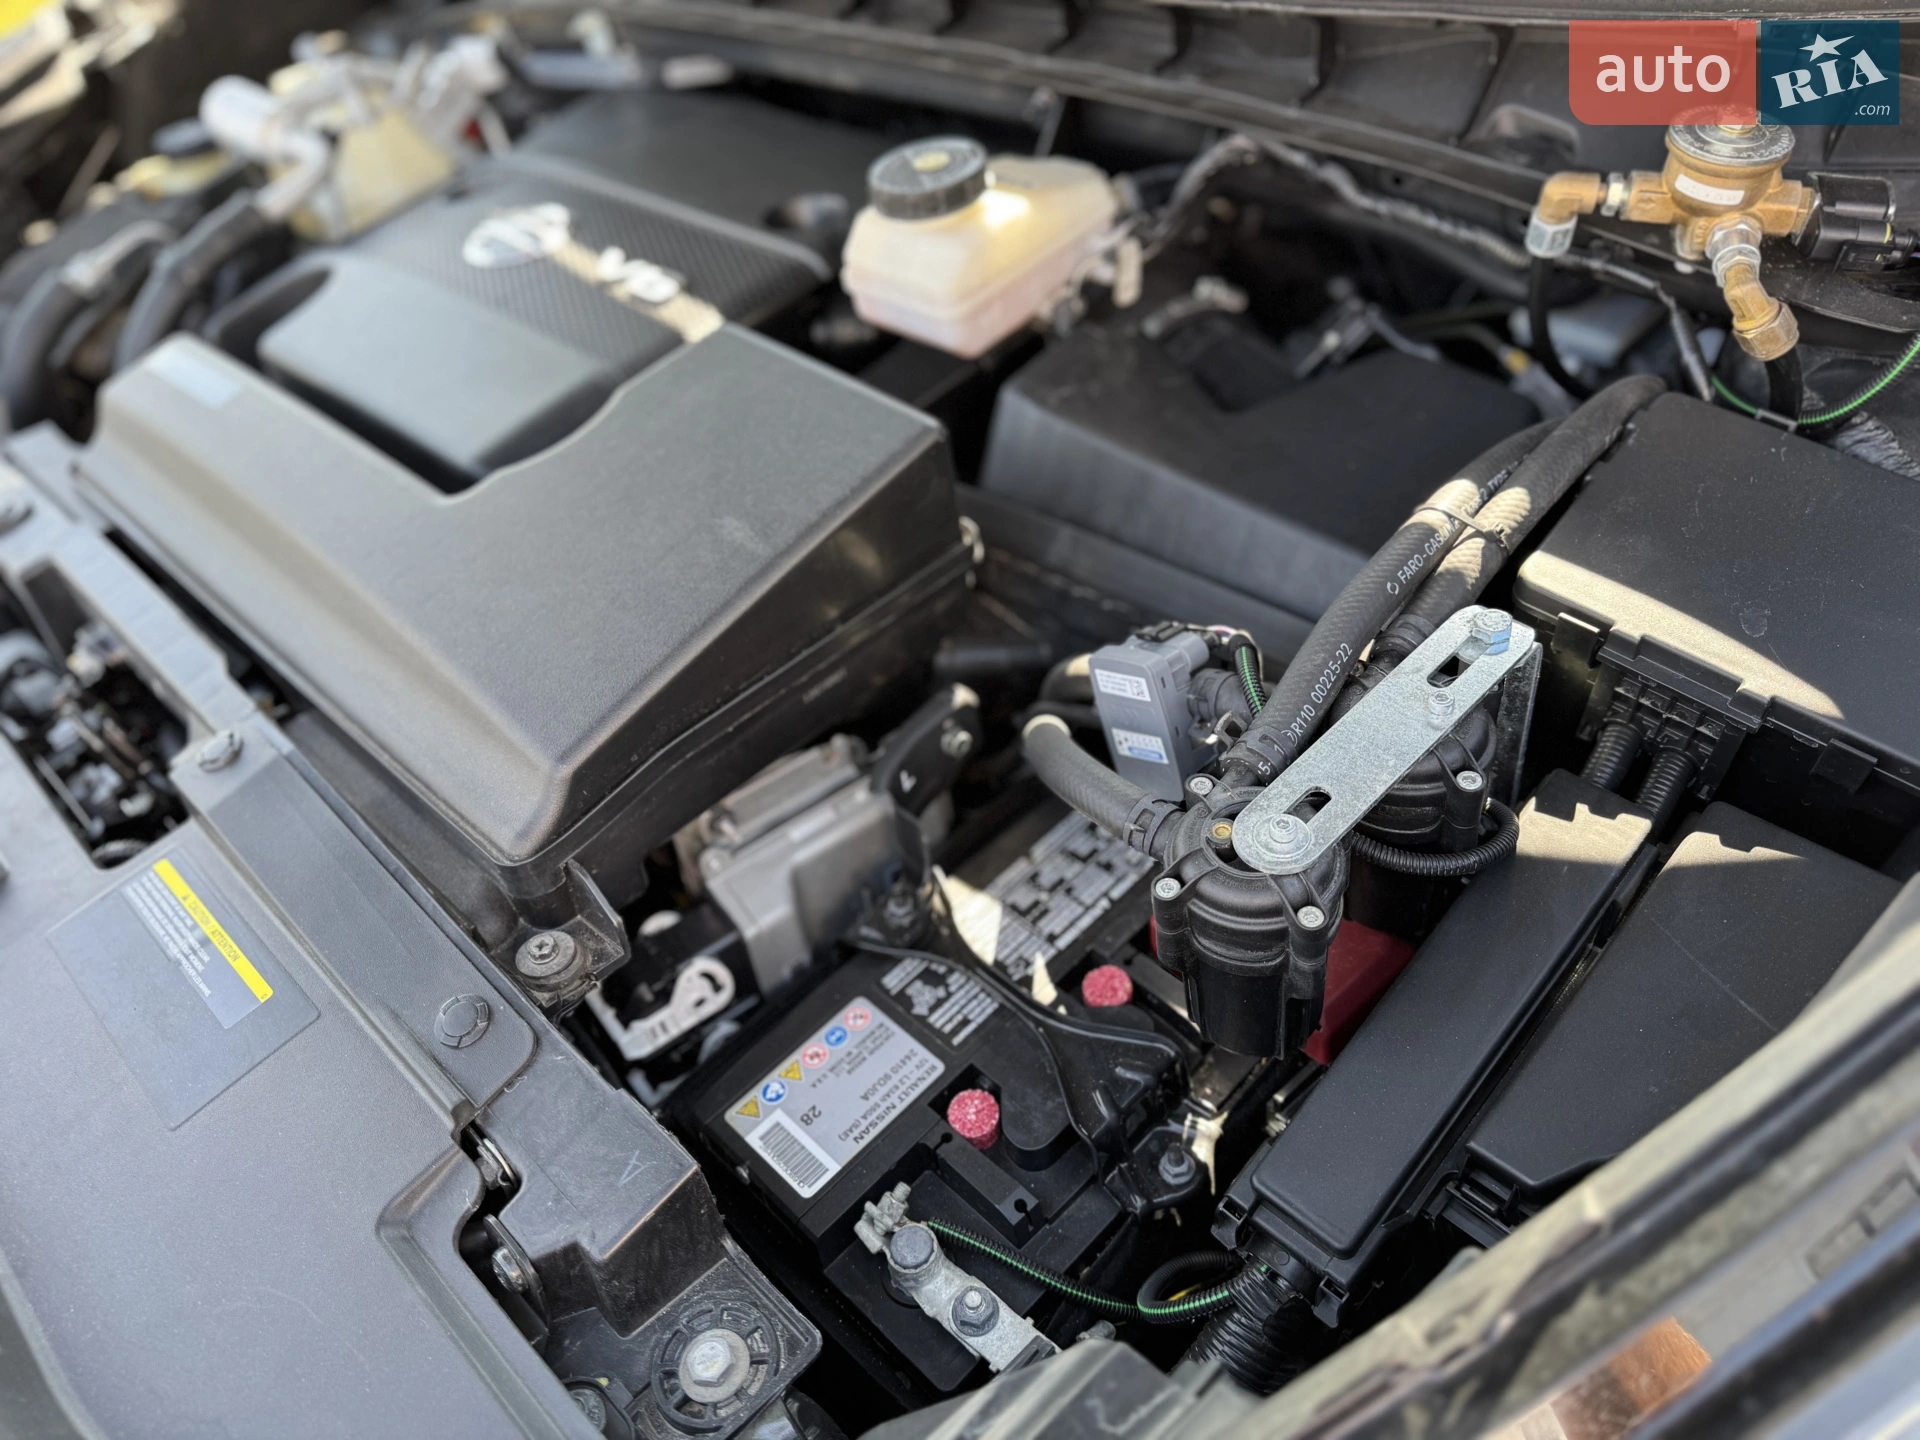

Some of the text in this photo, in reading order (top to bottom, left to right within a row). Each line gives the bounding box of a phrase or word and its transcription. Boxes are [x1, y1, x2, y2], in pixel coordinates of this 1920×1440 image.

[1310, 642, 1354, 705] 00225-22
[210, 928, 240, 962] ATTENTION
[798, 1103, 822, 1127] 28
[852, 1062, 937, 1144] RENAULT NISSAN
[836, 1117, 861, 1142] (SAE)
